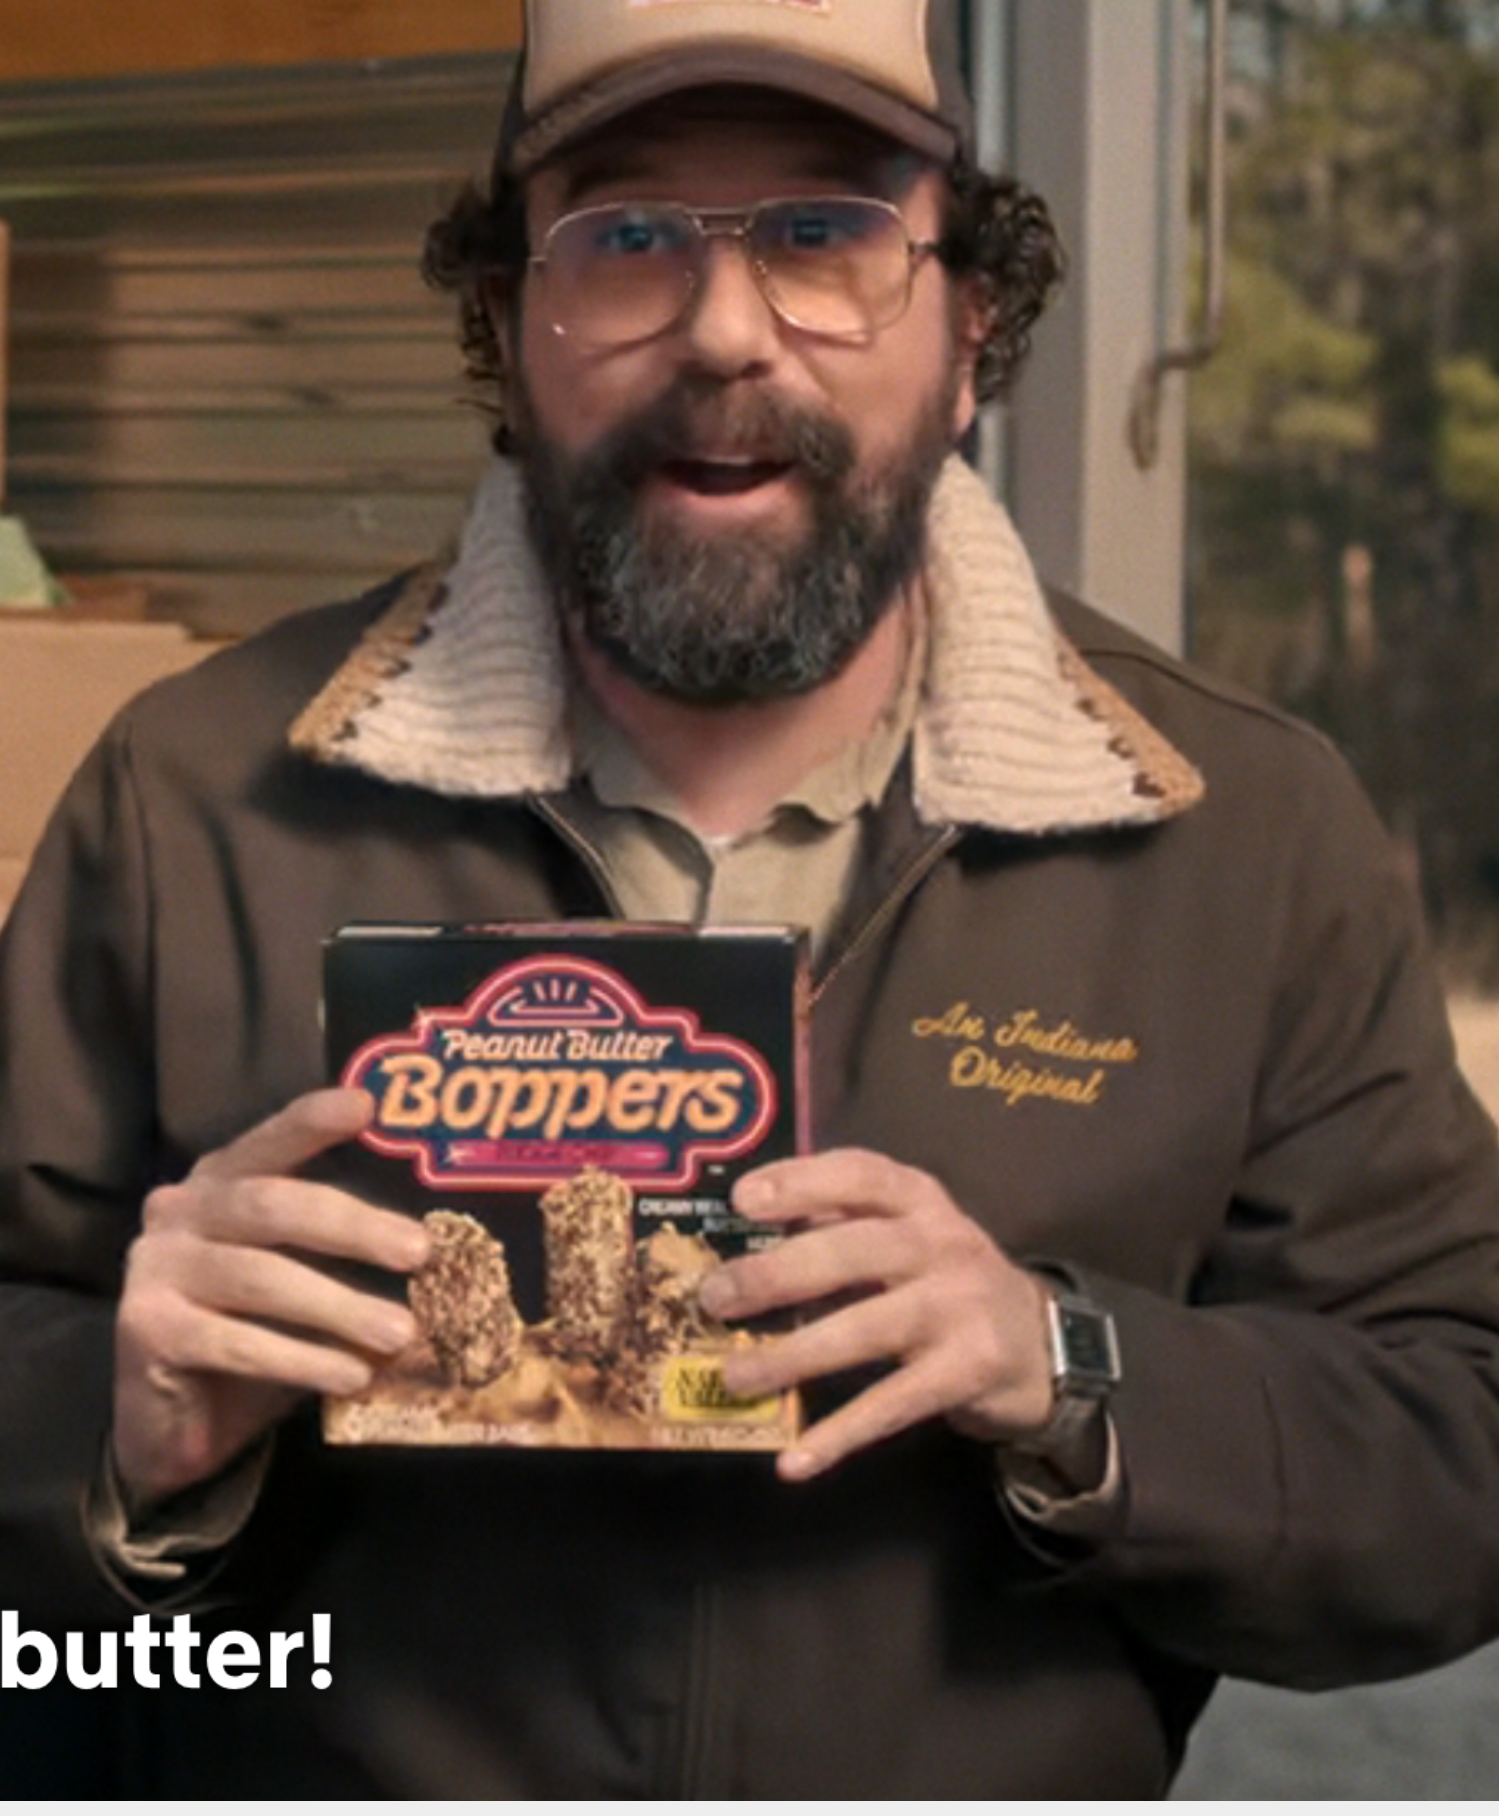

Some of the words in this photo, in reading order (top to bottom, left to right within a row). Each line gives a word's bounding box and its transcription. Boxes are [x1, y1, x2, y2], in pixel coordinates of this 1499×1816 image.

[440, 1029, 562, 1062] Peanut
[565, 1028, 675, 1062] Butter
[912, 1001, 986, 1040] An
[995, 1008, 1140, 1062] Indiana
[379, 1055, 745, 1140] Boppers
[950, 1045, 1105, 1106] Original
